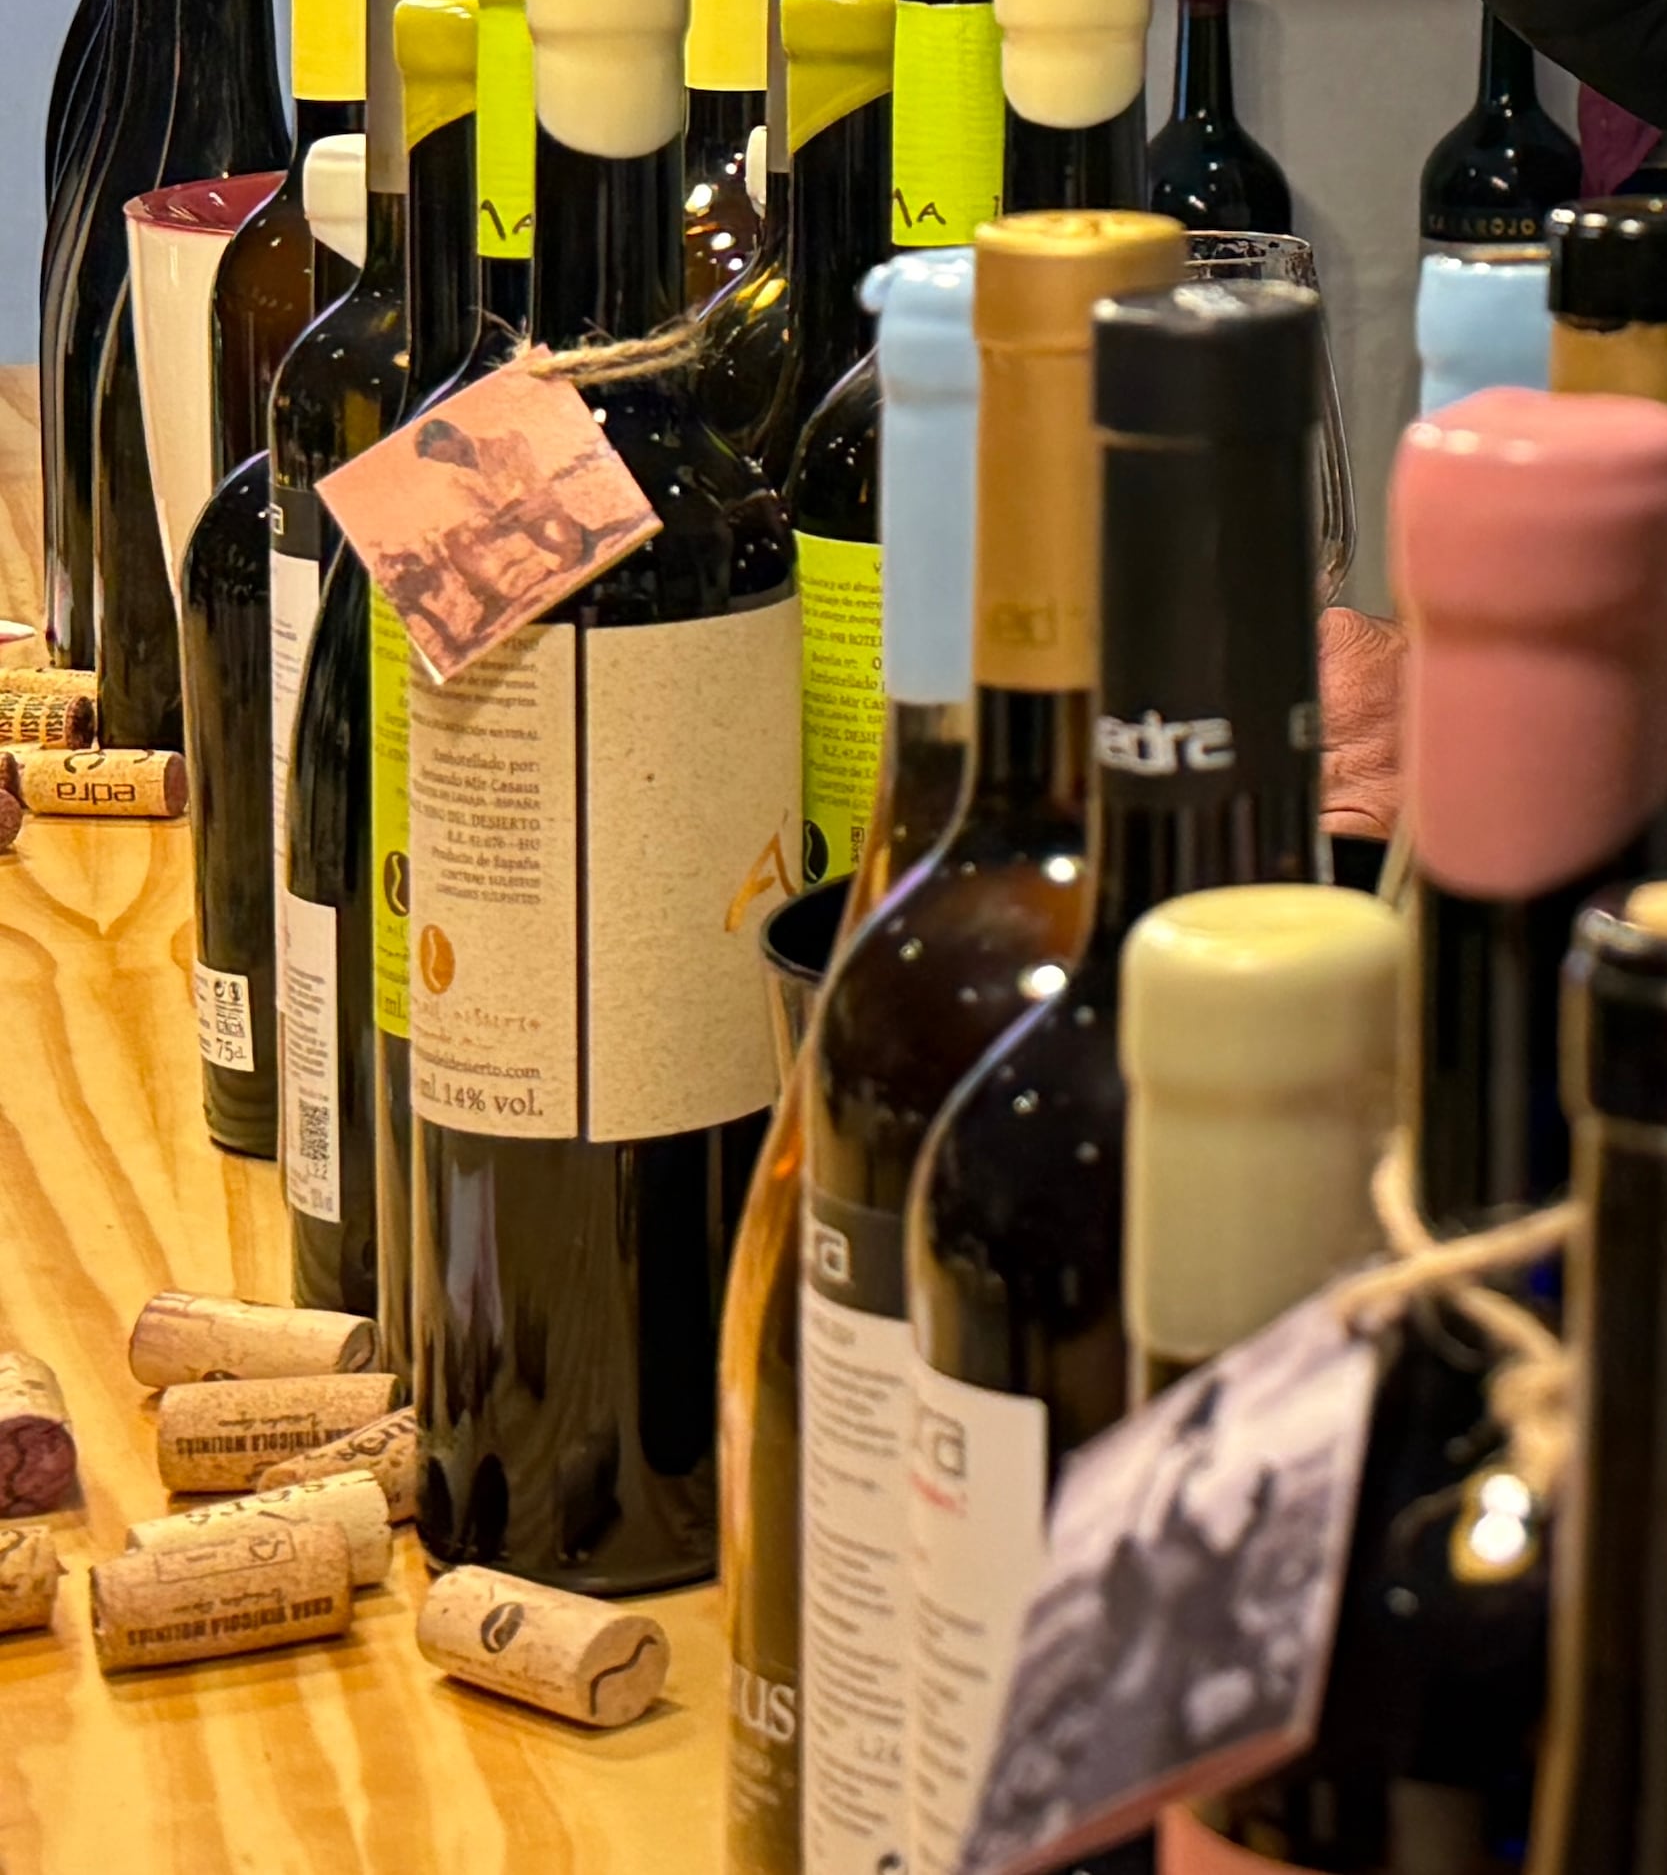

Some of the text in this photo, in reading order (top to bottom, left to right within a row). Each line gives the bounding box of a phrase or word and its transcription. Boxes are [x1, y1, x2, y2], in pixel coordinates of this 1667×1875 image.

[56, 781, 136, 806] edra
[471, 812, 541, 831] DESIERTO
[493, 1087, 544, 1117] vol.
